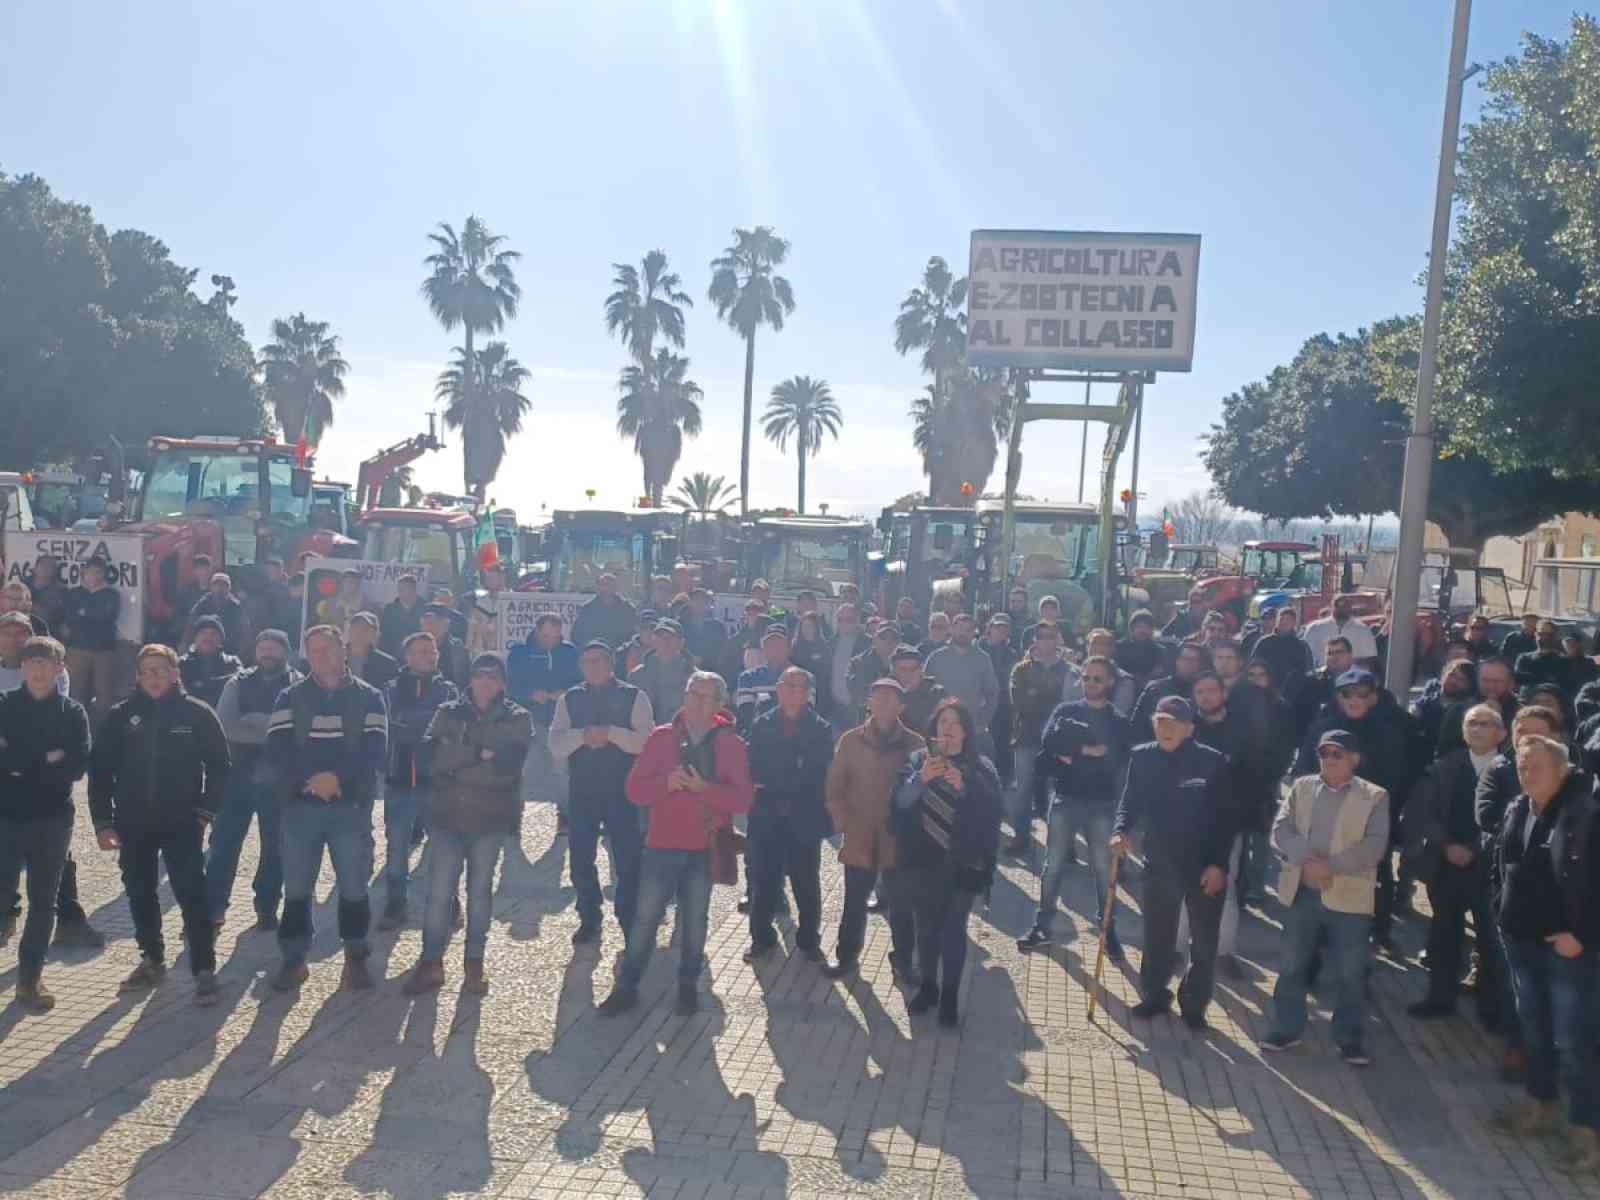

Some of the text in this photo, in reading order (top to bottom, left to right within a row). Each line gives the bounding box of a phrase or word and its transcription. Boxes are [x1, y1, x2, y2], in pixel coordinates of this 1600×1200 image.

[974, 248, 1182, 277] AGRICOLTURA
[969, 319, 1174, 348] AL COLLASSO
[36, 540, 112, 561] SENZA
[8, 561, 138, 587] AGCOORI
